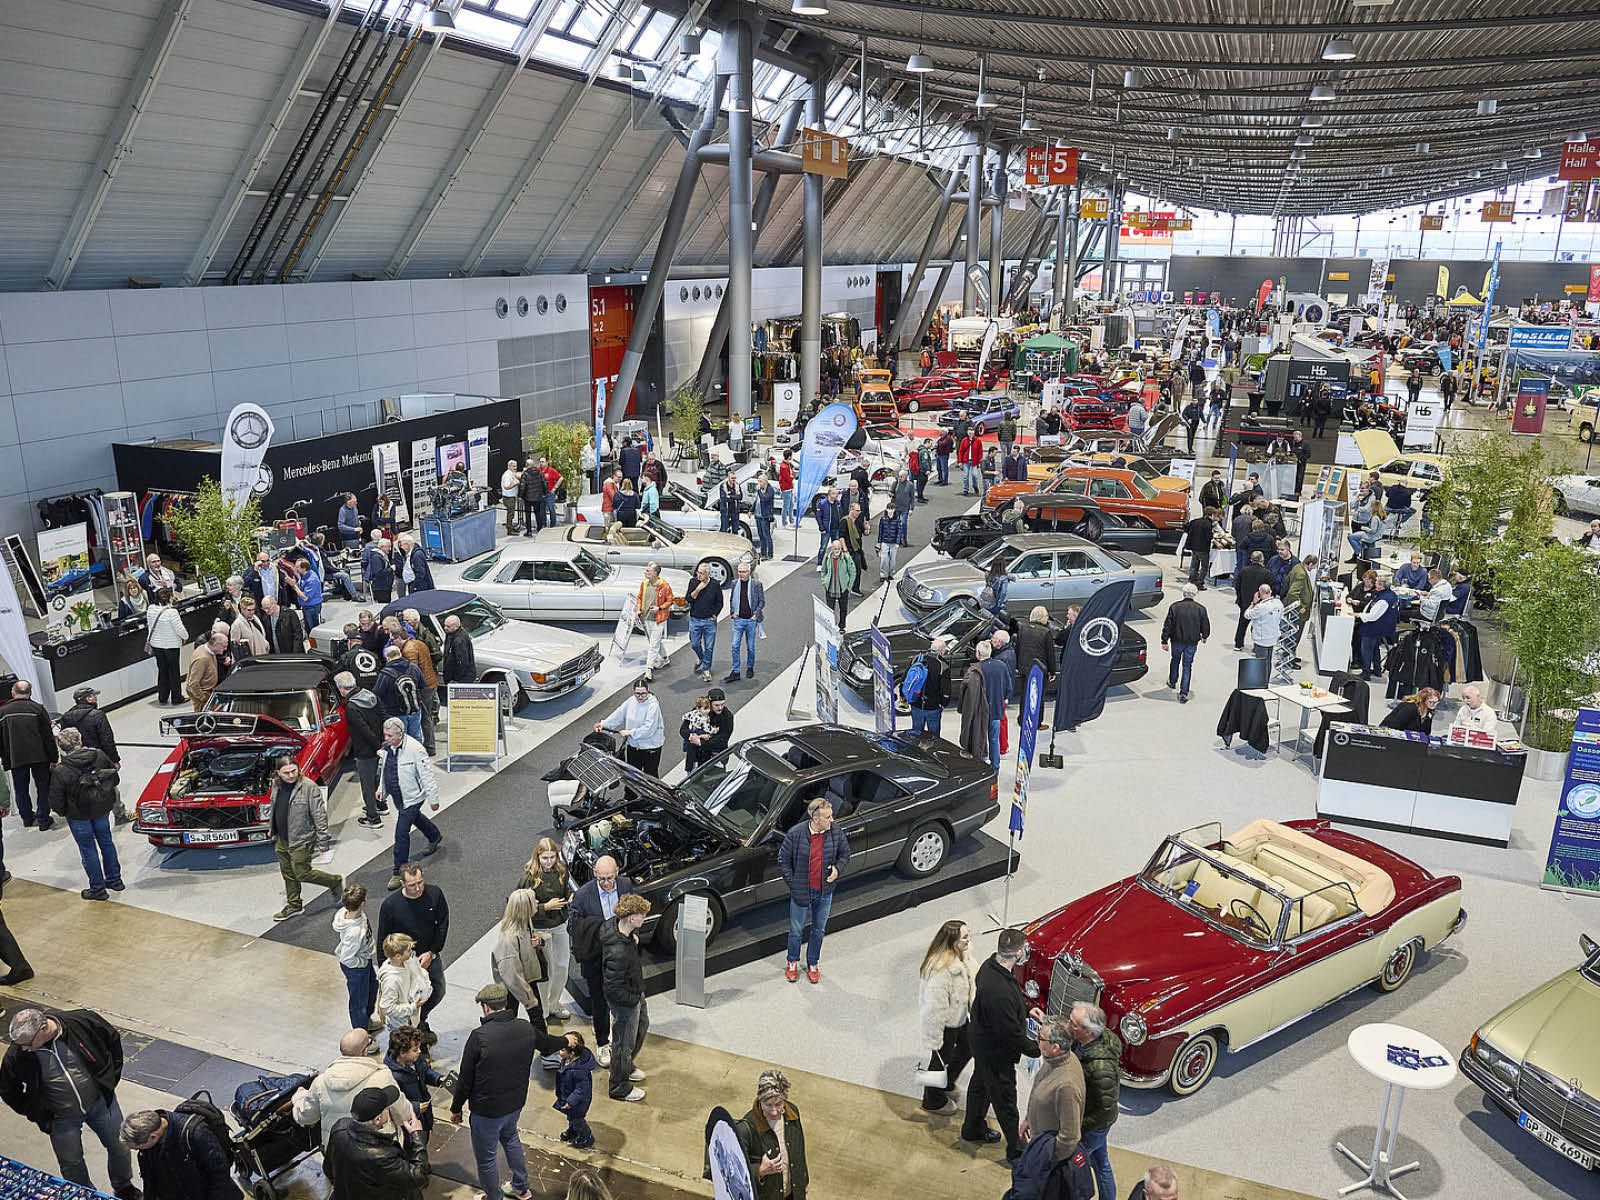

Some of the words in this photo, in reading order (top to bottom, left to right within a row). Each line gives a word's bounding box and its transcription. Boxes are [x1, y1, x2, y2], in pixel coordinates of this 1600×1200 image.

[1567, 143, 1596, 153] Halle
[1030, 151, 1053, 161] Hale
[1053, 151, 1068, 173] 5
[1564, 157, 1587, 168] Hall
[592, 298, 606, 316] 5.1
[283, 459, 341, 481] Mercedes-Benz
[1525, 1117, 1539, 1131] GP
[1544, 1130, 1560, 1148] DE
[1560, 1142, 1590, 1167] 469H
